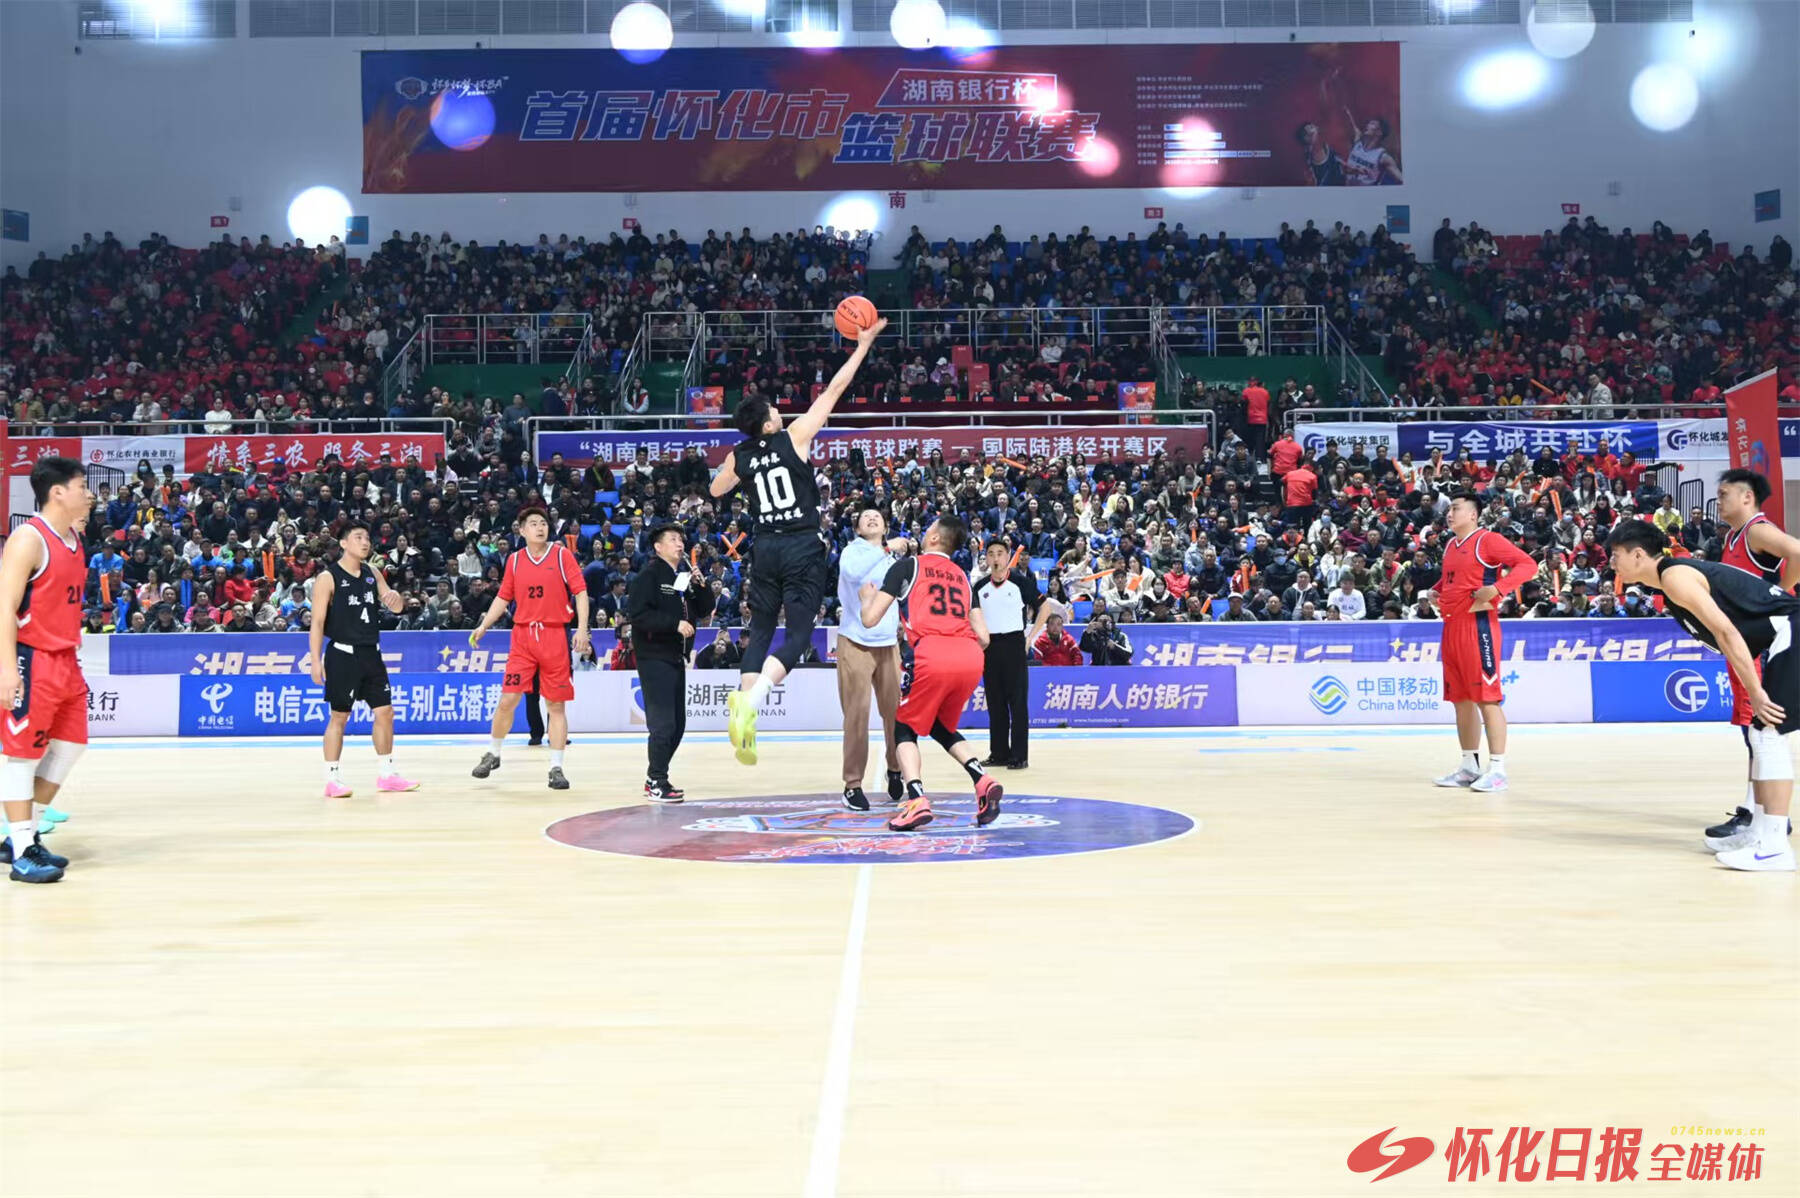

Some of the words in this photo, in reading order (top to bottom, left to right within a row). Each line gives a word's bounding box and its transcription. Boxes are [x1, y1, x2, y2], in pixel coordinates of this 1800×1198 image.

[902, 78, 1038, 102] 湖南银行杯
[519, 89, 849, 141] 首届怀化市
[833, 111, 1100, 163] 篮球联赛
[889, 191, 906, 209] 南
[983, 436, 1169, 458] 国际陆港经开赛区
[1425, 429, 1633, 454] 与全城共赴怀
[207, 440, 308, 468] 情系三农
[754, 466, 796, 513] 10
[528, 586, 544, 598] 23
[929, 584, 965, 619] 35
[360, 607, 370, 623] 4
[505, 674, 521, 686] 23
[1357, 677, 1438, 696] 中国移动
[1043, 683, 1208, 711] 湖南人的银行
[1358, 699, 1394, 711] China
[1398, 699, 1439, 711] Mobile
[686, 708, 717, 717] BANK
